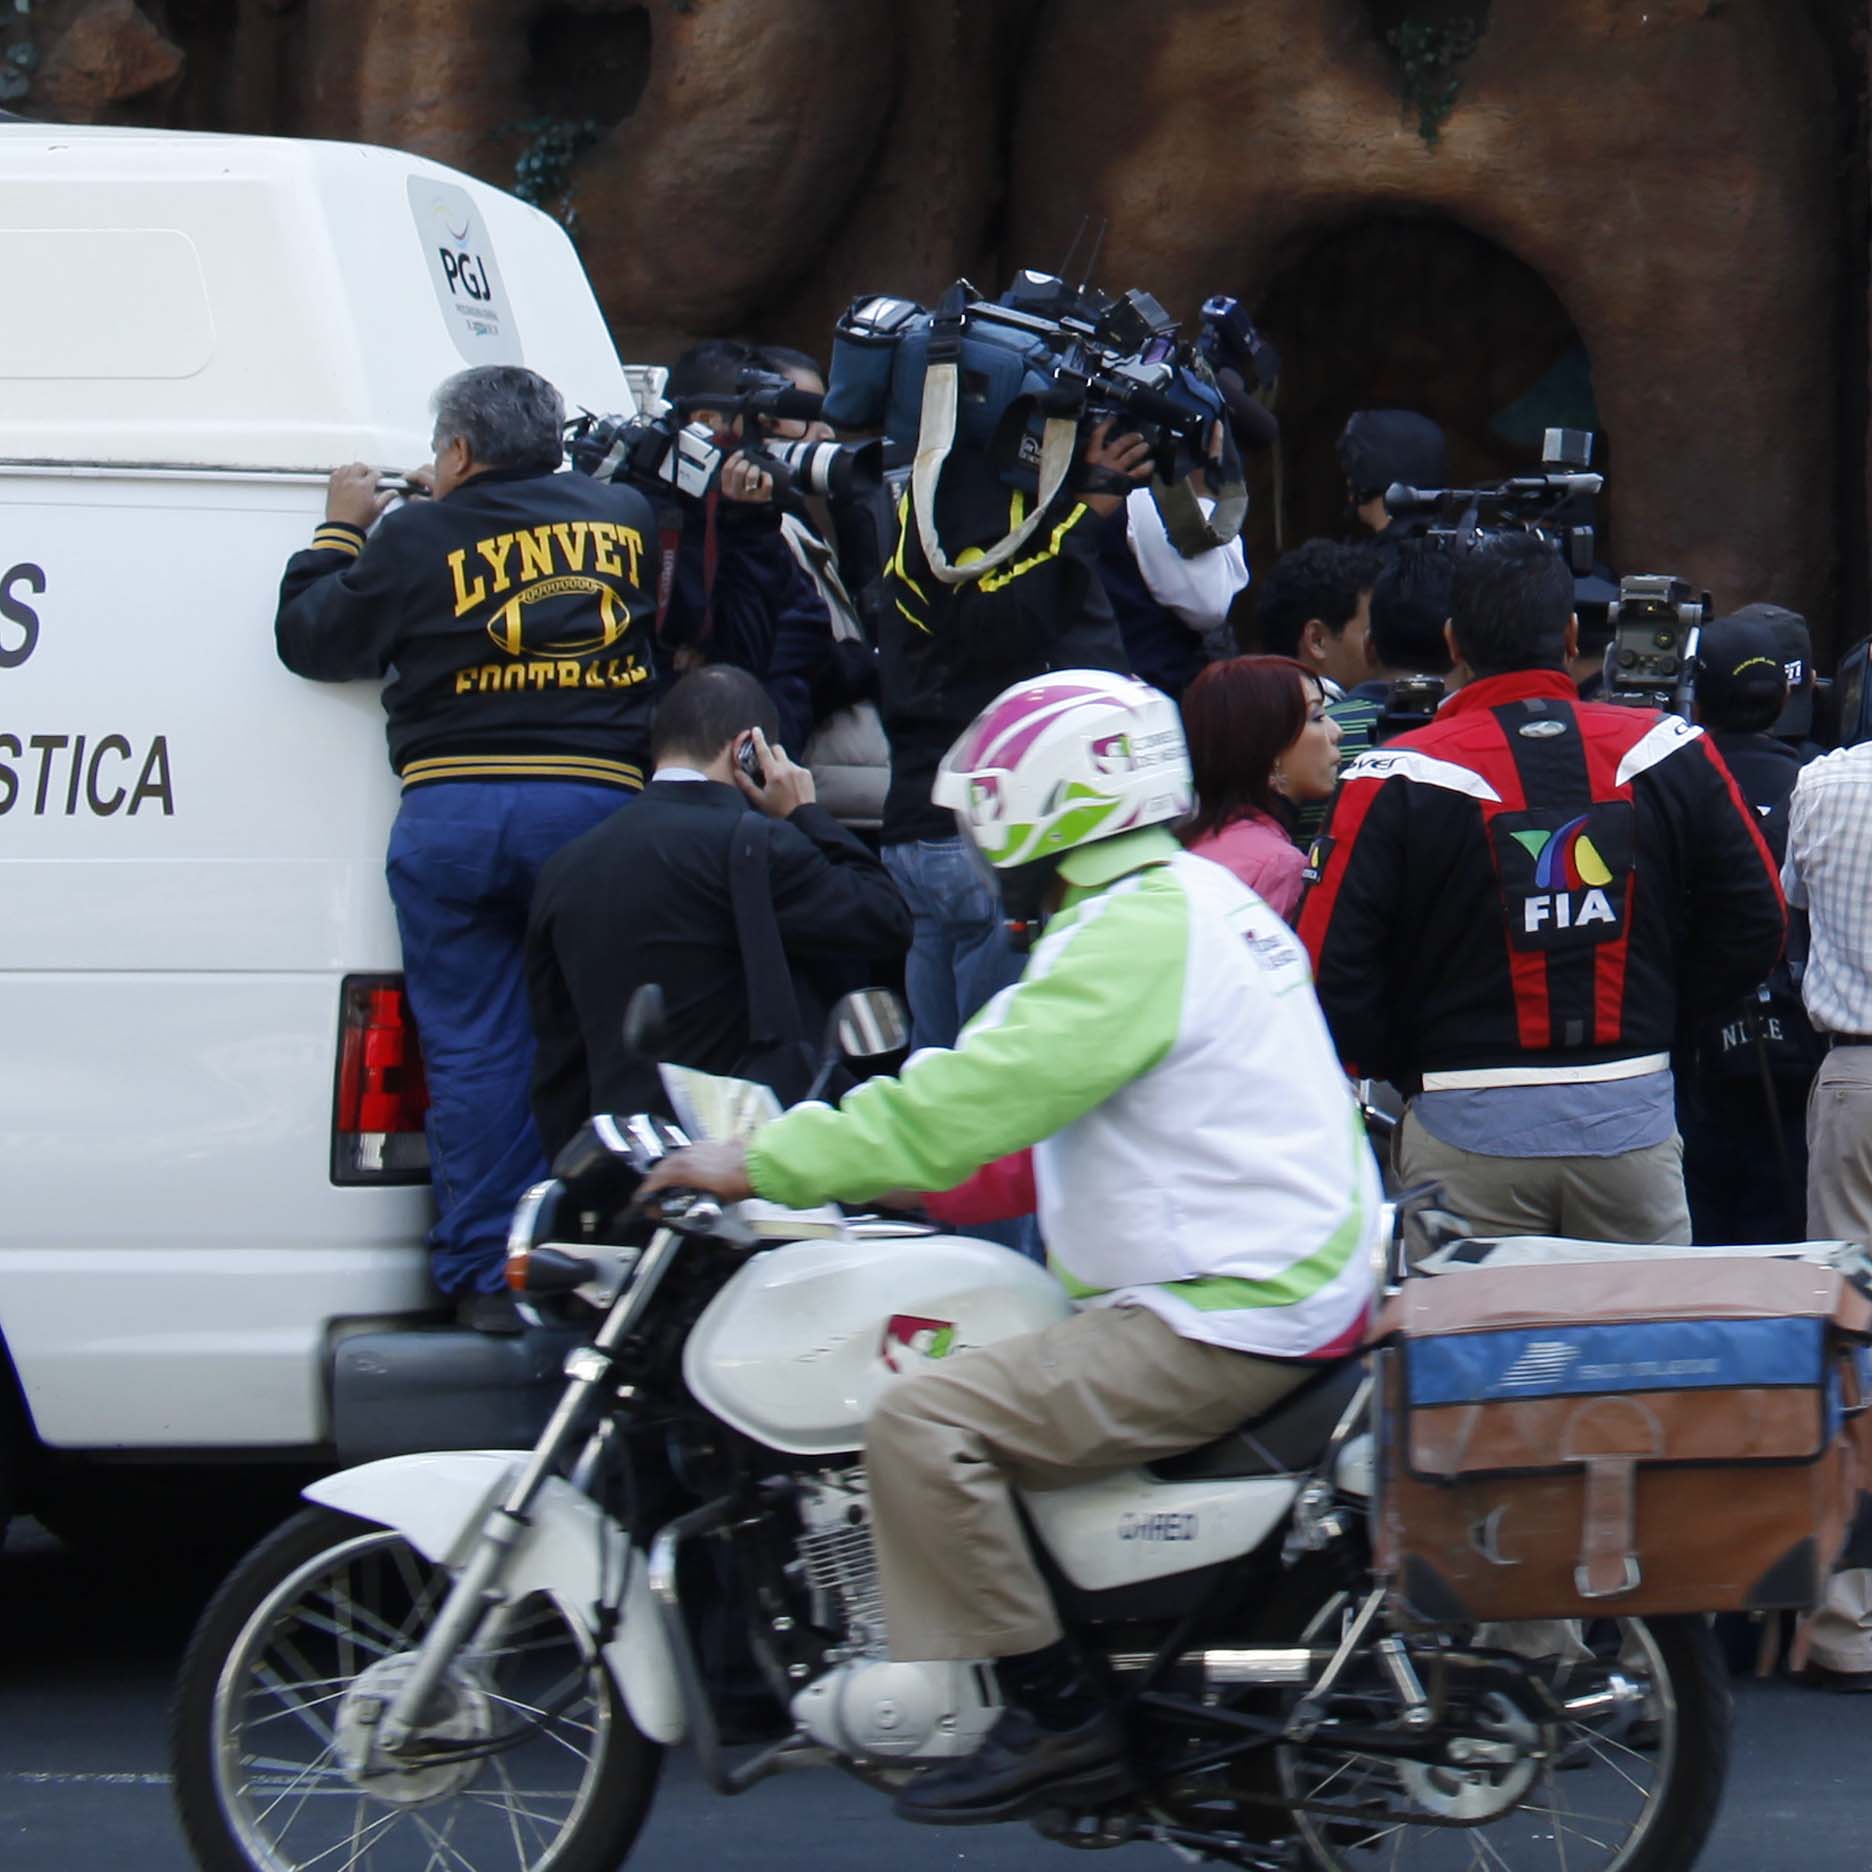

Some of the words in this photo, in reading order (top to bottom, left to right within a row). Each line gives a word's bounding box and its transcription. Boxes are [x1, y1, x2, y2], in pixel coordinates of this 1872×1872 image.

[438, 247, 491, 302] PGJ
[447, 521, 645, 618] LYNVET
[0, 733, 175, 817] STICA
[1523, 890, 1616, 933] FIA
[1721, 1017, 1784, 1052] NIE
